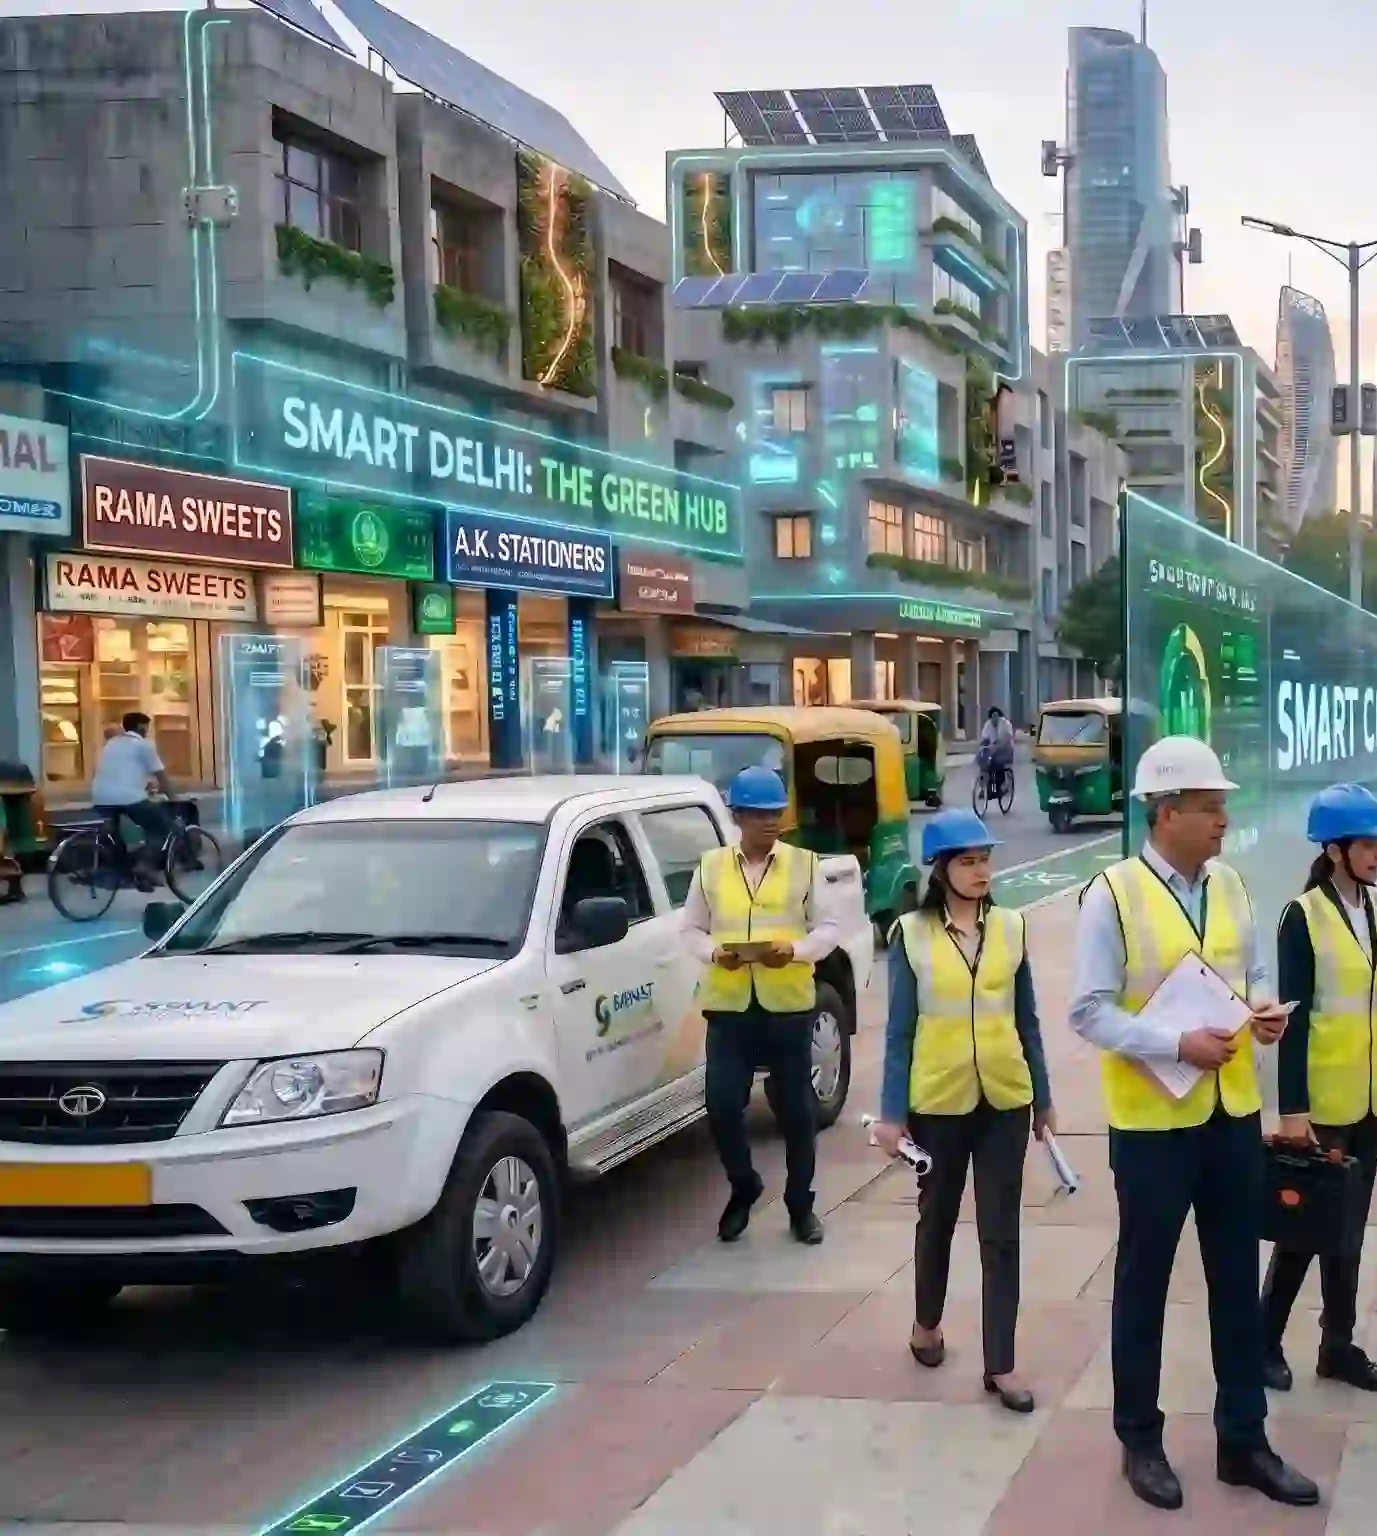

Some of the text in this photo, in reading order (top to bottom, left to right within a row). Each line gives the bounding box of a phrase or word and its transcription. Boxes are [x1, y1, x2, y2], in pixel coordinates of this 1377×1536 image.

[283, 397, 728, 534] SMART DELHI: THE GREEN HUB
[95, 485, 282, 542] RAMA SWEETS
[454, 526, 494, 559] A.K.
[498, 533, 605, 573] STATIONERS
[56, 560, 139, 592] RAMA
[147, 568, 247, 600] SWEETS
[1277, 680, 1359, 771] SMART
